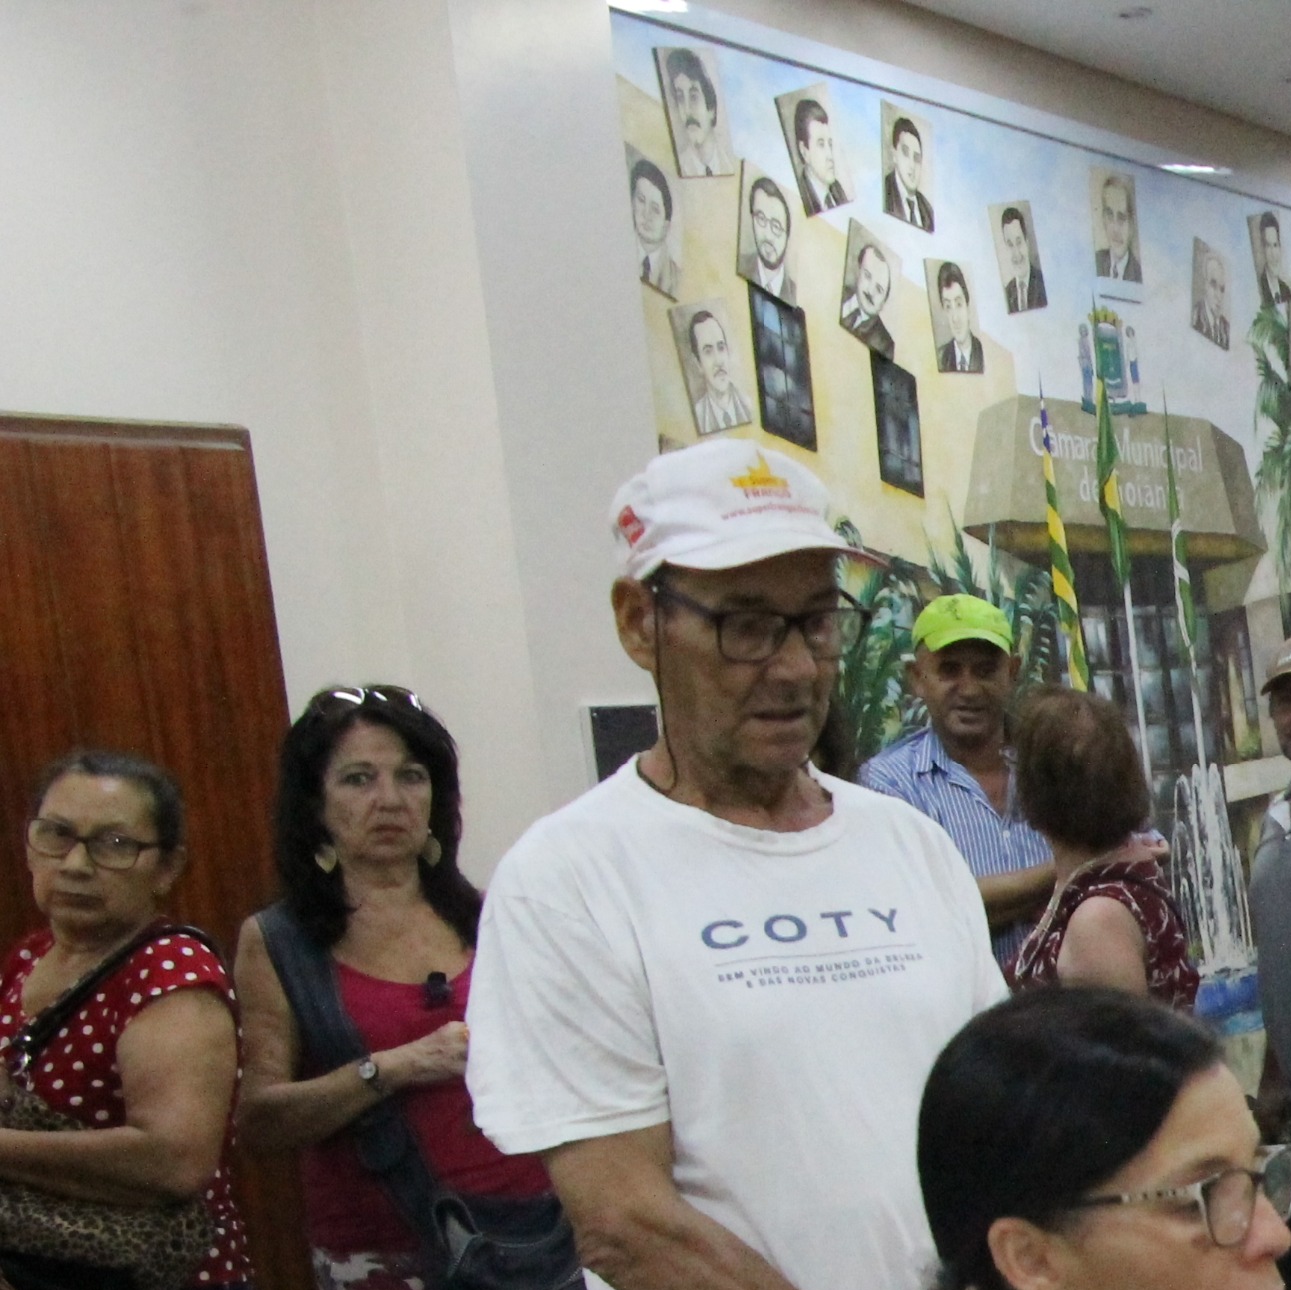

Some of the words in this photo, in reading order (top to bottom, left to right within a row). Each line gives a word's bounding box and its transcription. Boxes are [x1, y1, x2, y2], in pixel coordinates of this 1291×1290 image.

[701, 908, 897, 949] COTY
[750, 965, 789, 977] VINDO
[815, 960, 860, 973] MUNDO
[787, 975, 826, 985] NOVAS
